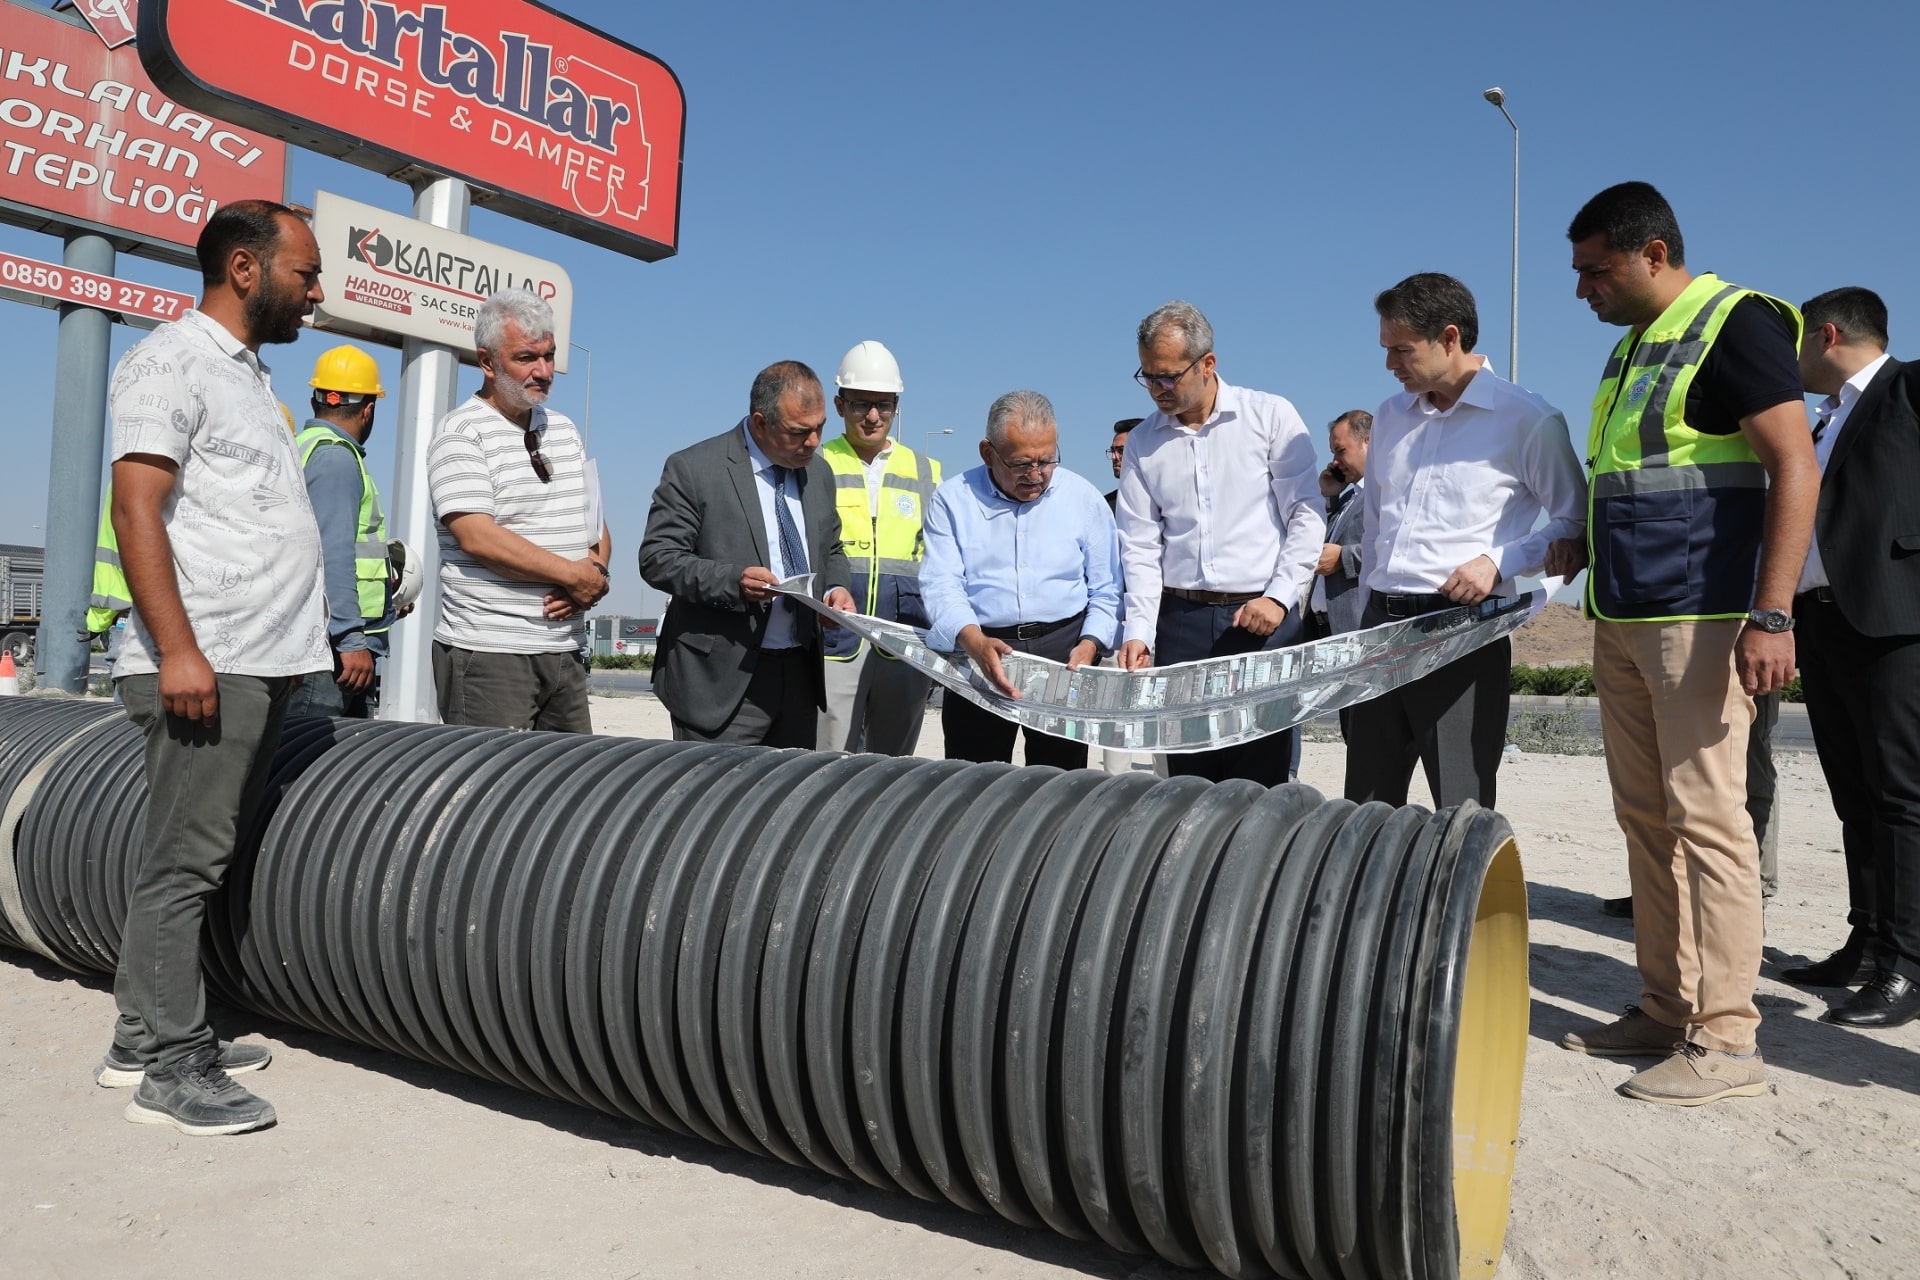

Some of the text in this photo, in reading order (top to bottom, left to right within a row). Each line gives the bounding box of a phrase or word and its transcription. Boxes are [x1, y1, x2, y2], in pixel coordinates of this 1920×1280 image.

[226, 0, 631, 156] artallar
[0, 48, 264, 168] KLAVACI
[288, 39, 626, 190] DORSE & DAMPER
[2, 260, 179, 316] 0850 399 27 27
[345, 274, 413, 304] HARDOX
[355, 294, 402, 312] WEARPARTS
[421, 295, 447, 312] SAC
